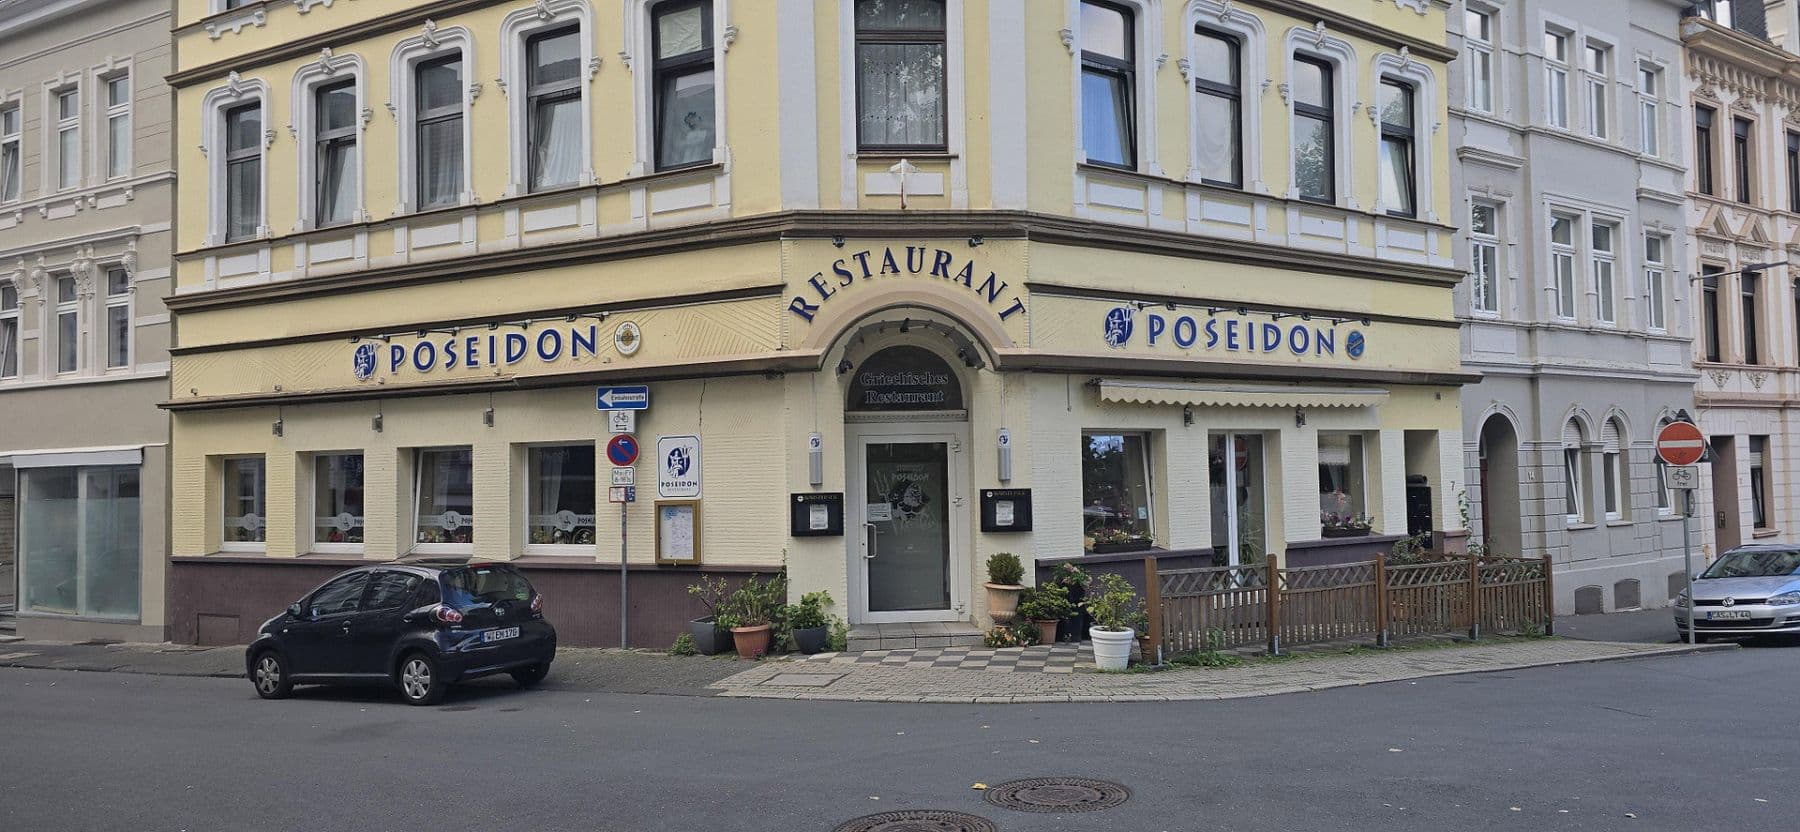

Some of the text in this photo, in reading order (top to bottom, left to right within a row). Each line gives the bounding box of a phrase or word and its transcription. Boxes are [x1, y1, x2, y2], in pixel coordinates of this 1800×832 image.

[787, 245, 1027, 323] RESTAURANT
[1147, 313, 1336, 357] POSEIDON
[389, 324, 599, 373] POSEIDON
[860, 372, 949, 386] Griechisches
[865, 389, 944, 405] Restaurant
[661, 480, 698, 488] POSEIDON
[1450, 480, 1456, 491] 7
